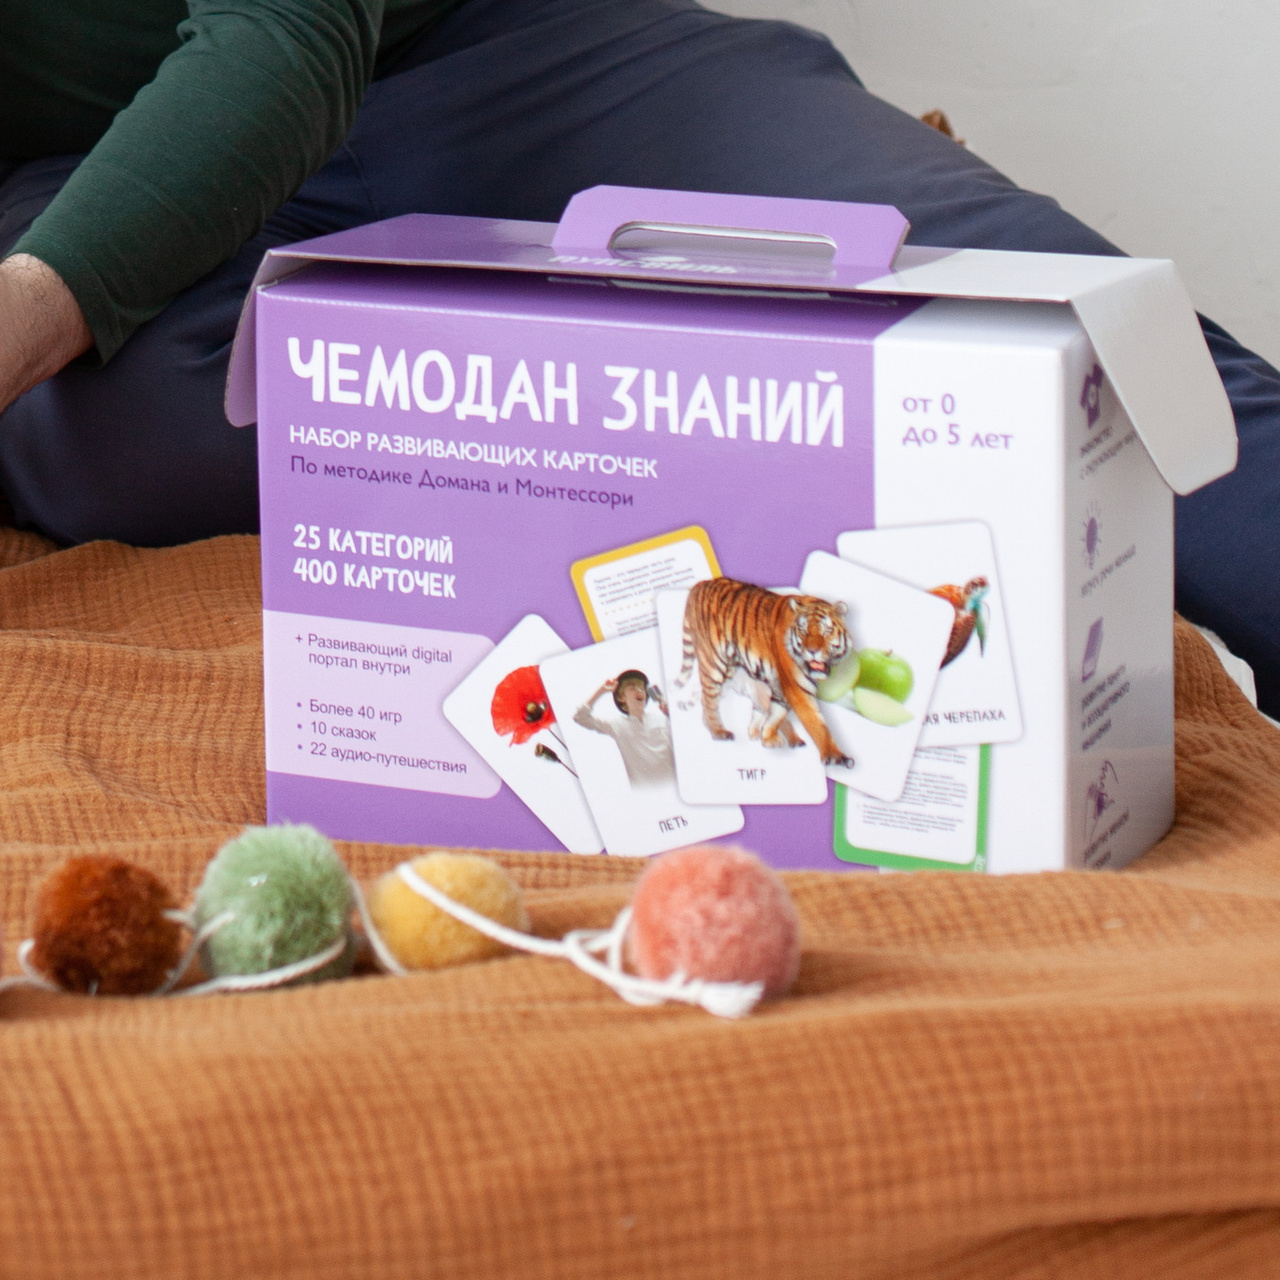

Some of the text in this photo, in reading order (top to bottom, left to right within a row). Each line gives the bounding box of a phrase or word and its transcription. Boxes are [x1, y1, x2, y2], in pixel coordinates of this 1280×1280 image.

[287, 337, 844, 448] ЧЕМОДАН ЗНАНИЙ
[902, 393, 955, 415] от 0
[902, 423, 1014, 449] до 5 лет
[290, 425, 658, 479] НАБОР РАЗВИВАЮЩИХ КАРТОЧЕК
[291, 455, 633, 509] По методике Домана и Монтессори
[293, 523, 453, 564] 25 КАТЕГОРИЙ
[293, 557, 456, 599] 400 КАРТОЧЕК
[308, 633, 408, 658] Развивающий
[412, 646, 452, 664] digital
[309, 652, 410, 676] портал внутри
[310, 699, 402, 725] Более 40 игр
[922, 708, 1006, 726] АЯ ЧЕРЕПАХА
[311, 721, 377, 741] 10 сказок
[310, 742, 467, 774] 22 аудио-путешествия
[737, 768, 766, 781] ТИГР
[658, 815, 688, 834] ПЕТЬ
